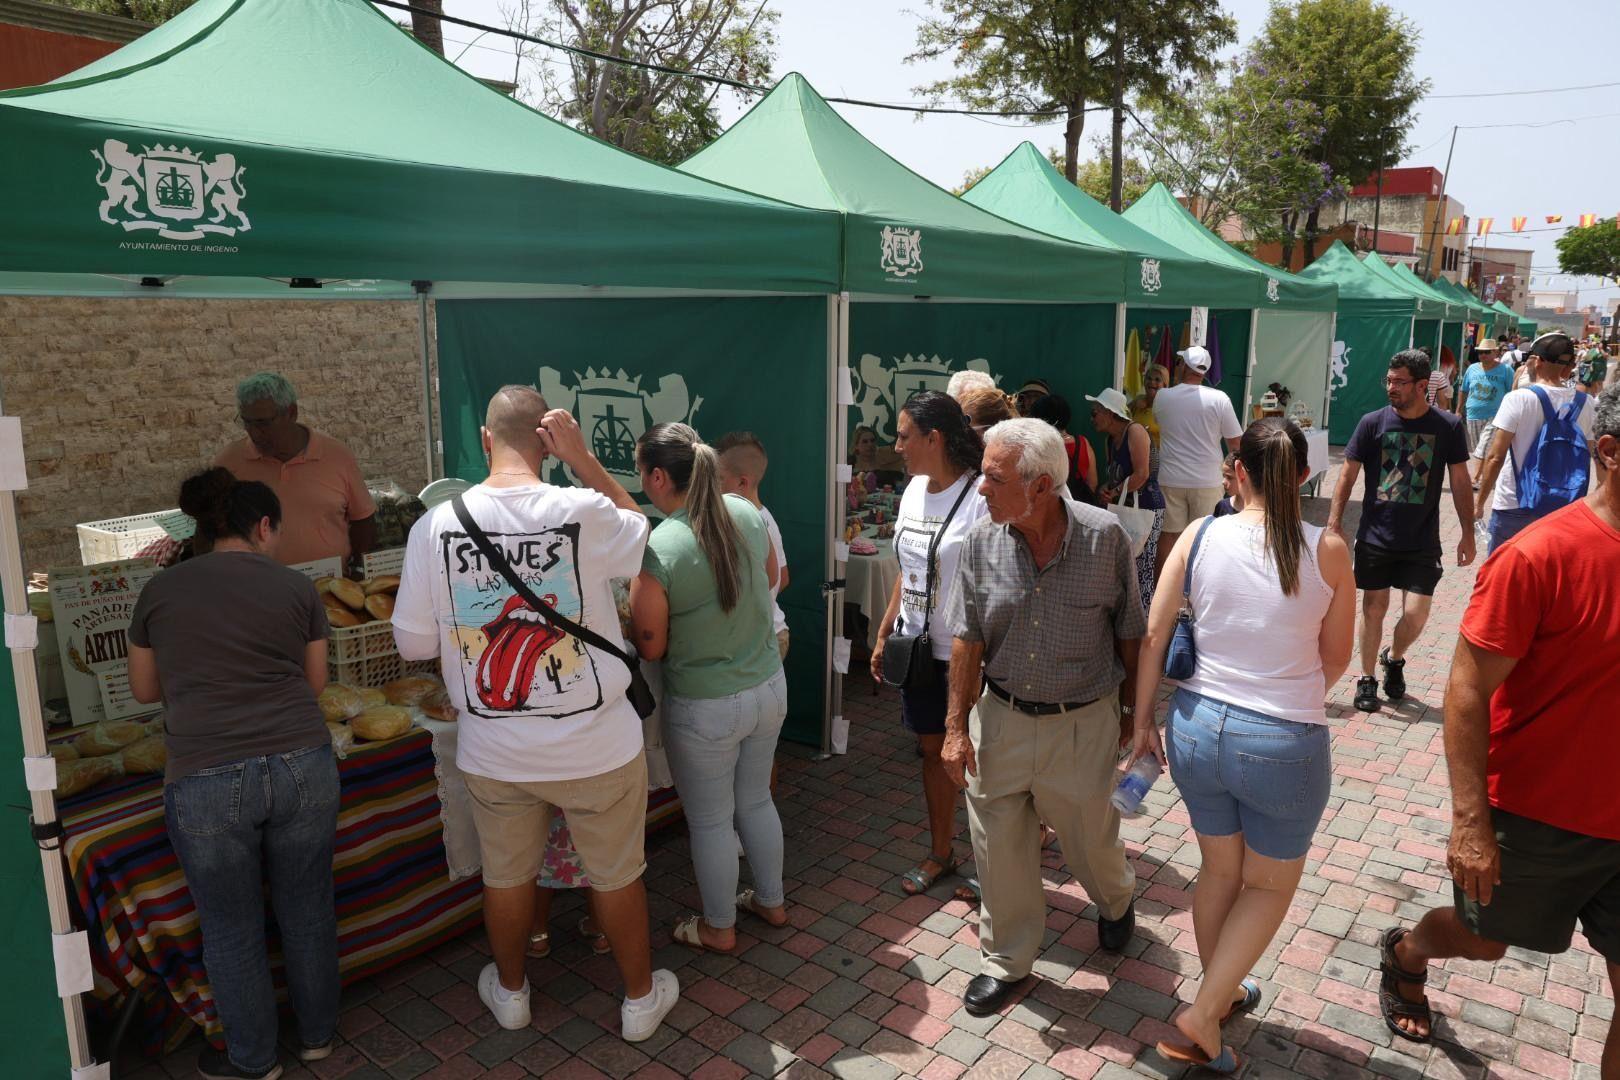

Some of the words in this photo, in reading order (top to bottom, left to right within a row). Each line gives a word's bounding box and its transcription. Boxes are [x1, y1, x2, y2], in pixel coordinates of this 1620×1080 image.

[119, 241, 189, 252] AYUNTAMIENTO
[190, 244, 203, 252] DE
[204, 244, 239, 253] INGENIO
[475, 573, 501, 593] LAS
[507, 571, 544, 588] GAS
